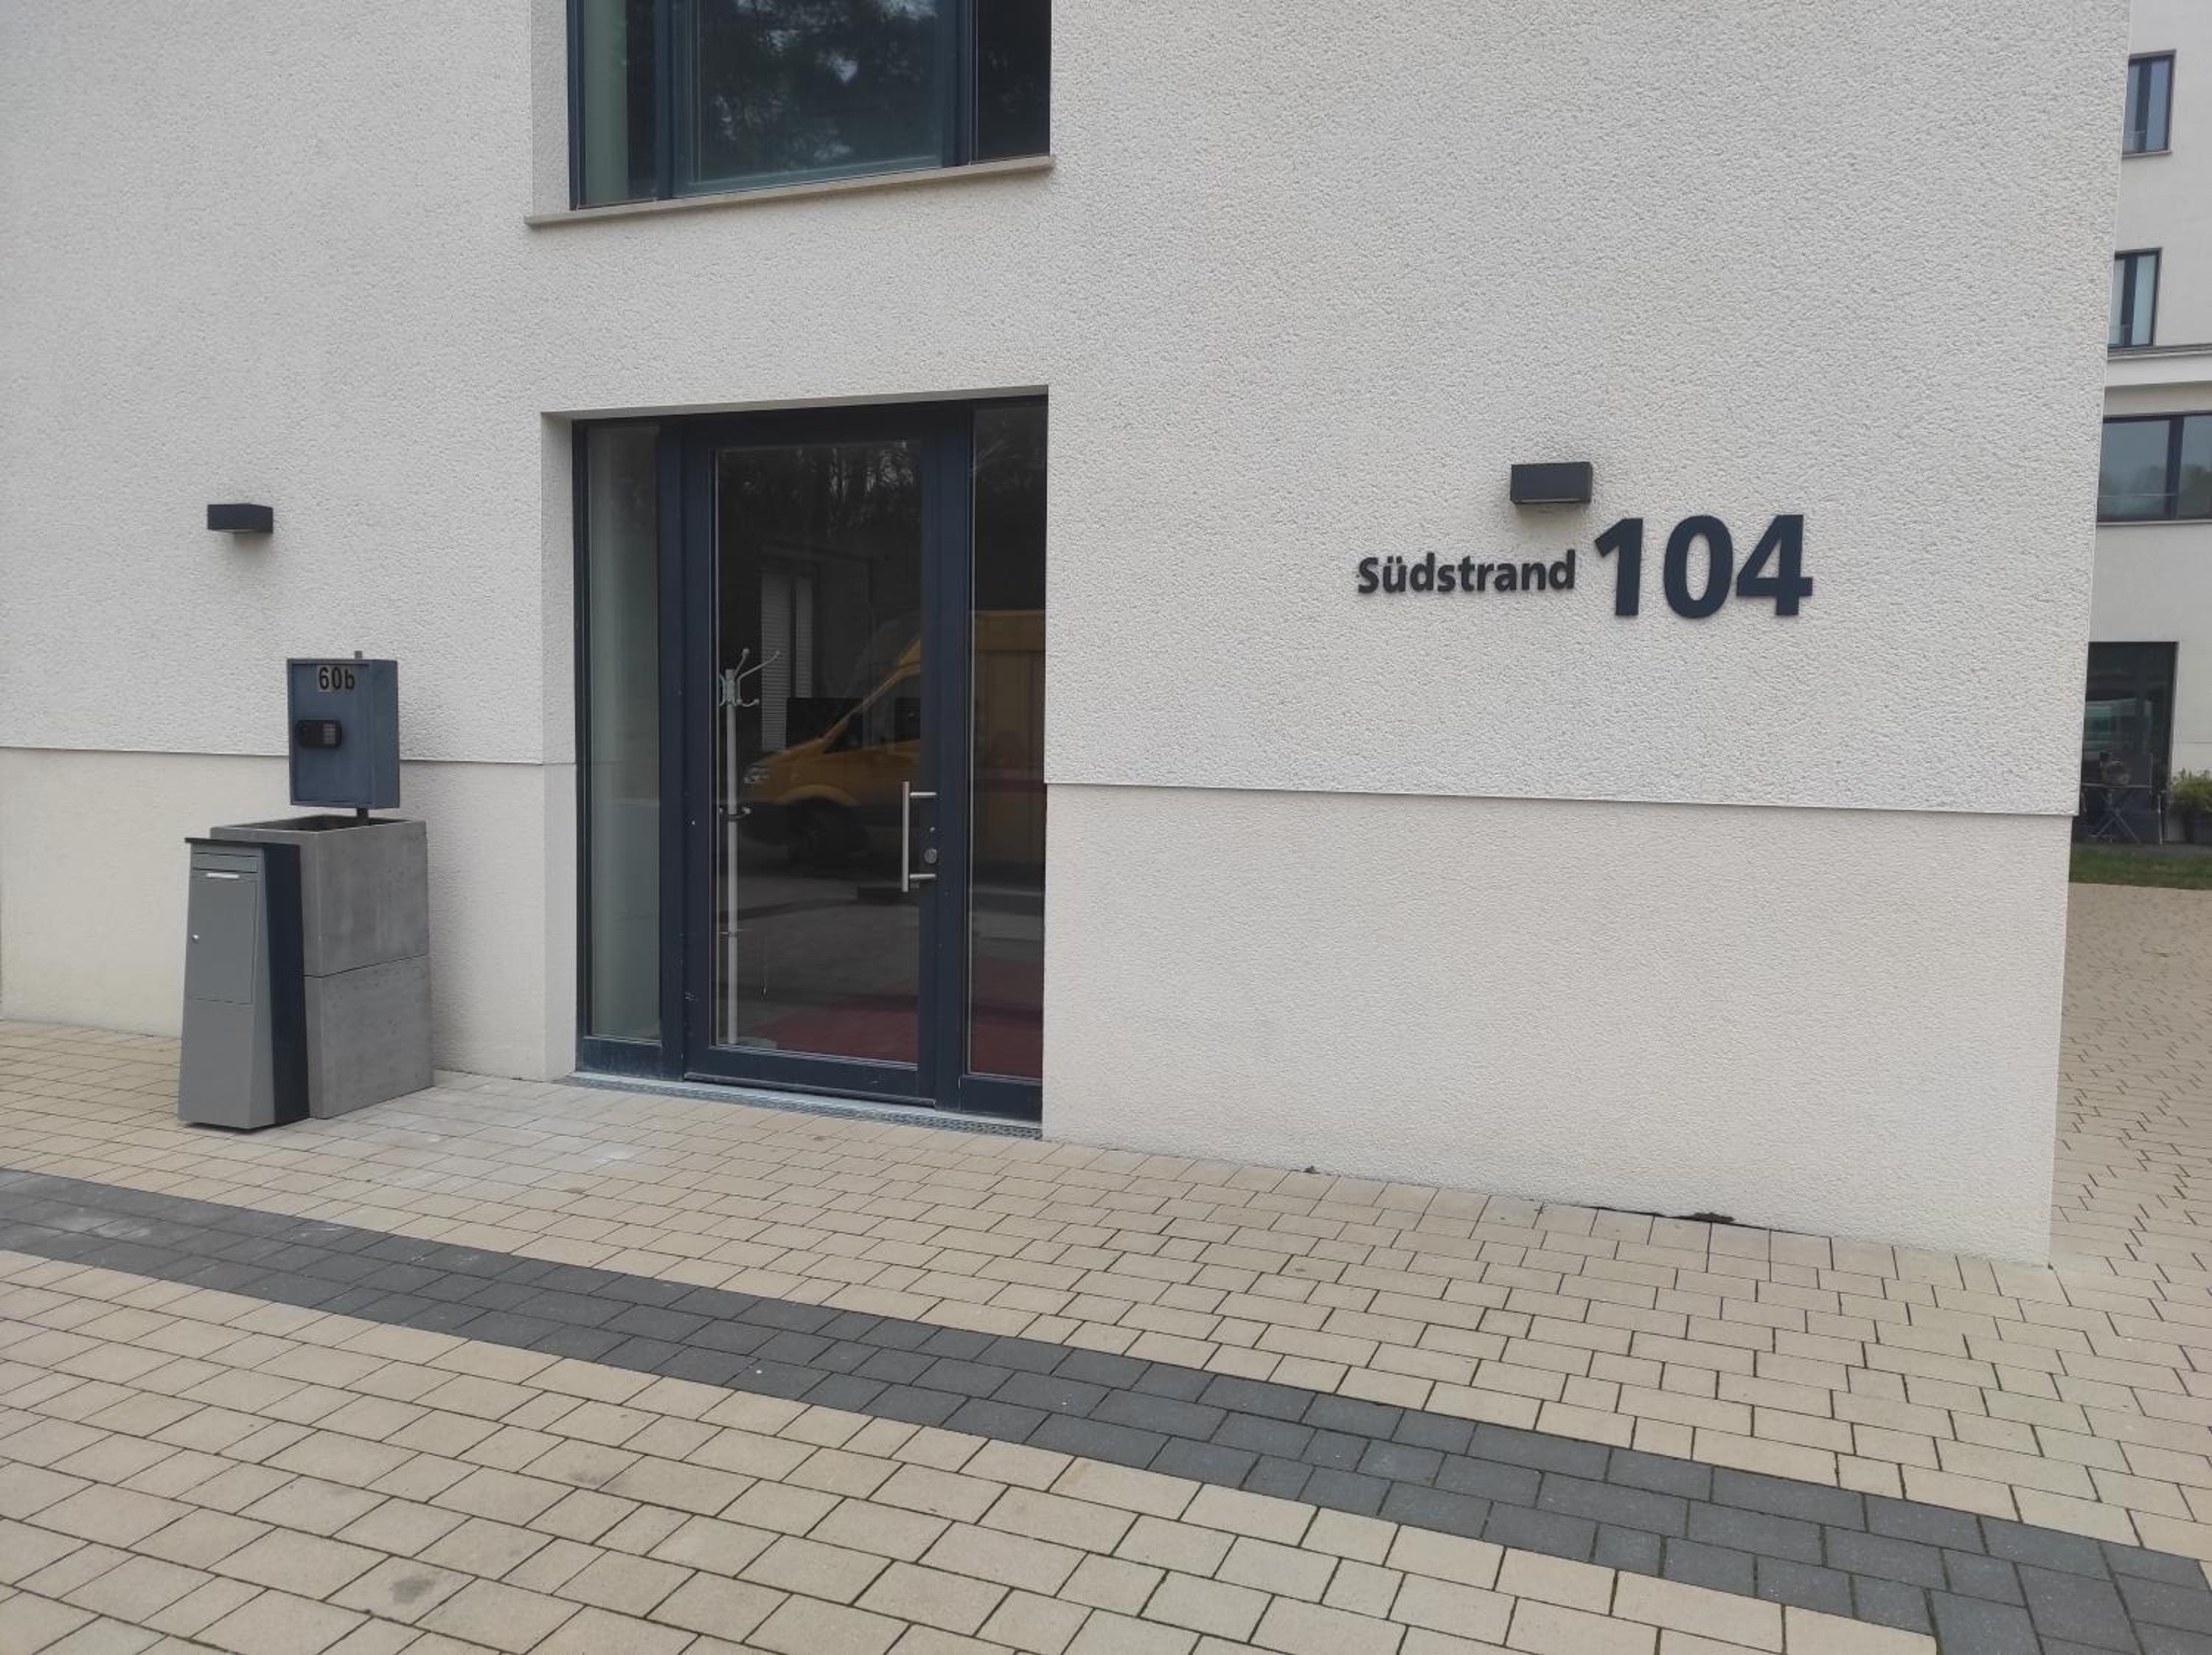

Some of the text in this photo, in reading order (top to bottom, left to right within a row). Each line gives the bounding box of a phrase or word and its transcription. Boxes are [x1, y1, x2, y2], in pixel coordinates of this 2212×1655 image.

[1357, 515, 1813, 618] Südstrand 104
[319, 667, 355, 690] 60b
